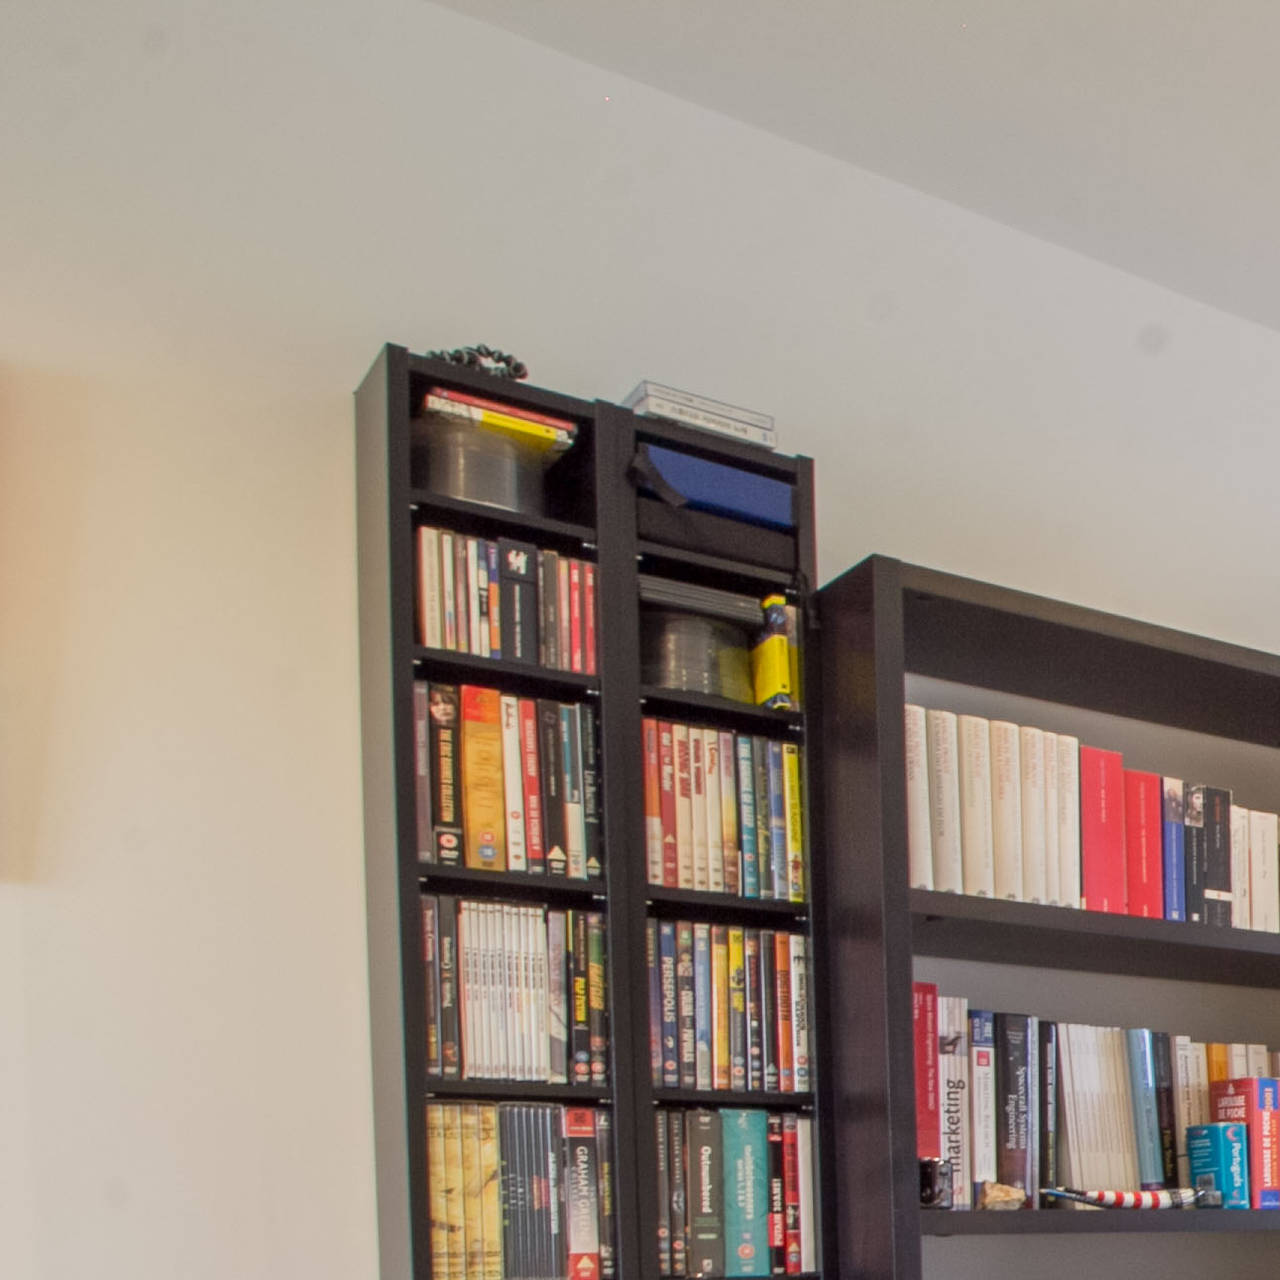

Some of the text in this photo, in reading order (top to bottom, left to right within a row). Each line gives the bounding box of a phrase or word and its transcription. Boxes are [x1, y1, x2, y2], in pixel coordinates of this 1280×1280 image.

[662, 956, 675, 1022] PERSEPOLIS
[945, 1079, 966, 1173] marketing
[1006, 1094, 1017, 1149] Engineering
[1017, 1065, 1027, 1149] Spacecraft Systems
[576, 1146, 589, 1195] GRAHAM
[701, 1146, 712, 1213] Outnumbered
